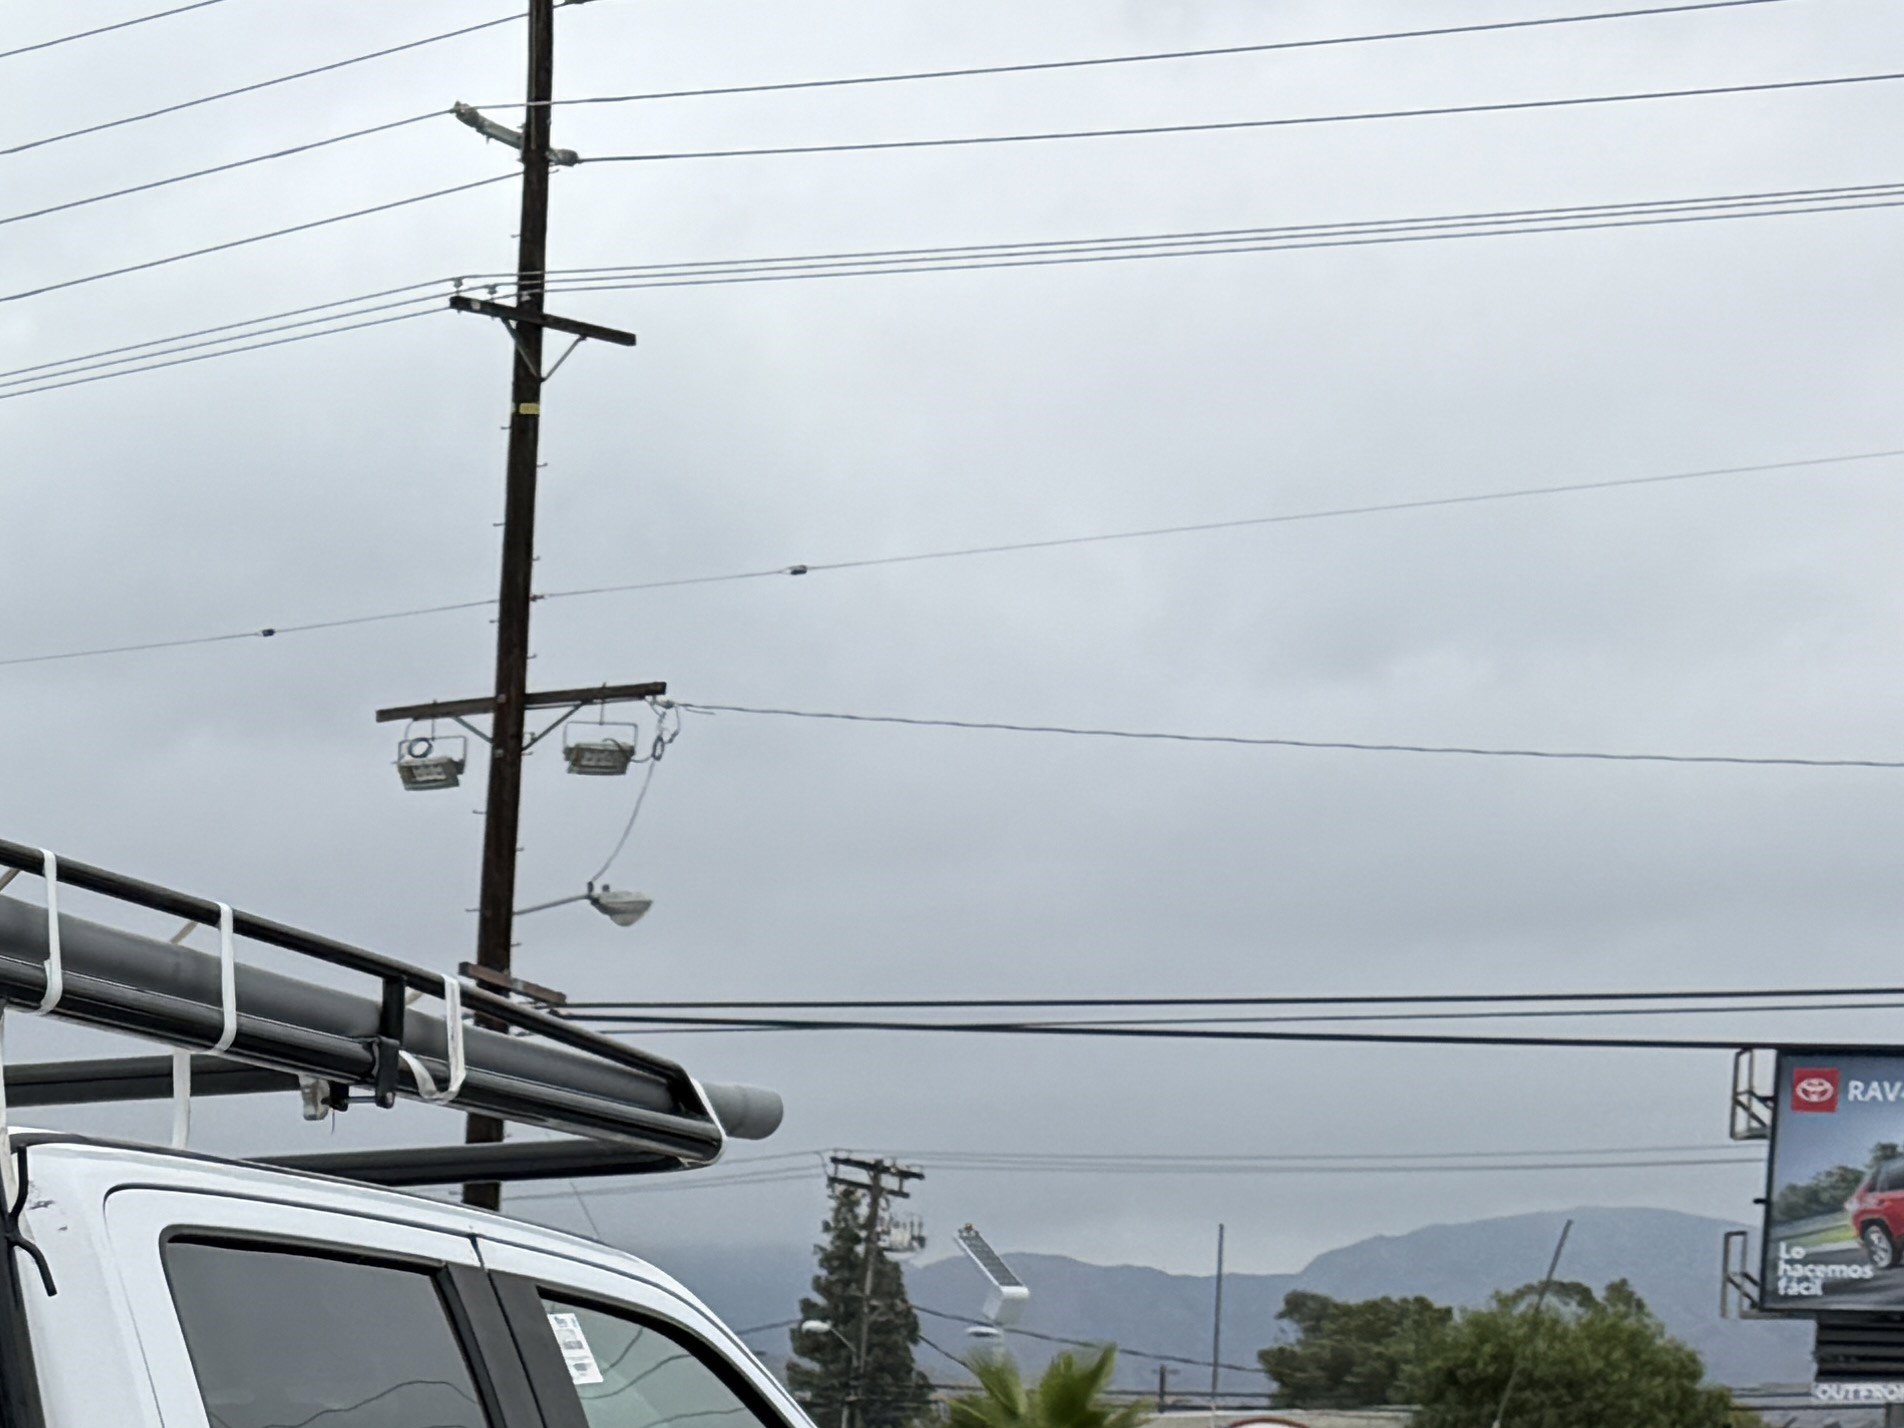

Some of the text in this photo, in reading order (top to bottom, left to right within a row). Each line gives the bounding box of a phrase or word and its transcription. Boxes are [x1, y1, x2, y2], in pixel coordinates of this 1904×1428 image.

[1848, 1080, 1904, 1101] RAV
[1779, 1241, 1806, 1259] Lo
[1778, 1259, 1874, 1279] hacemos
